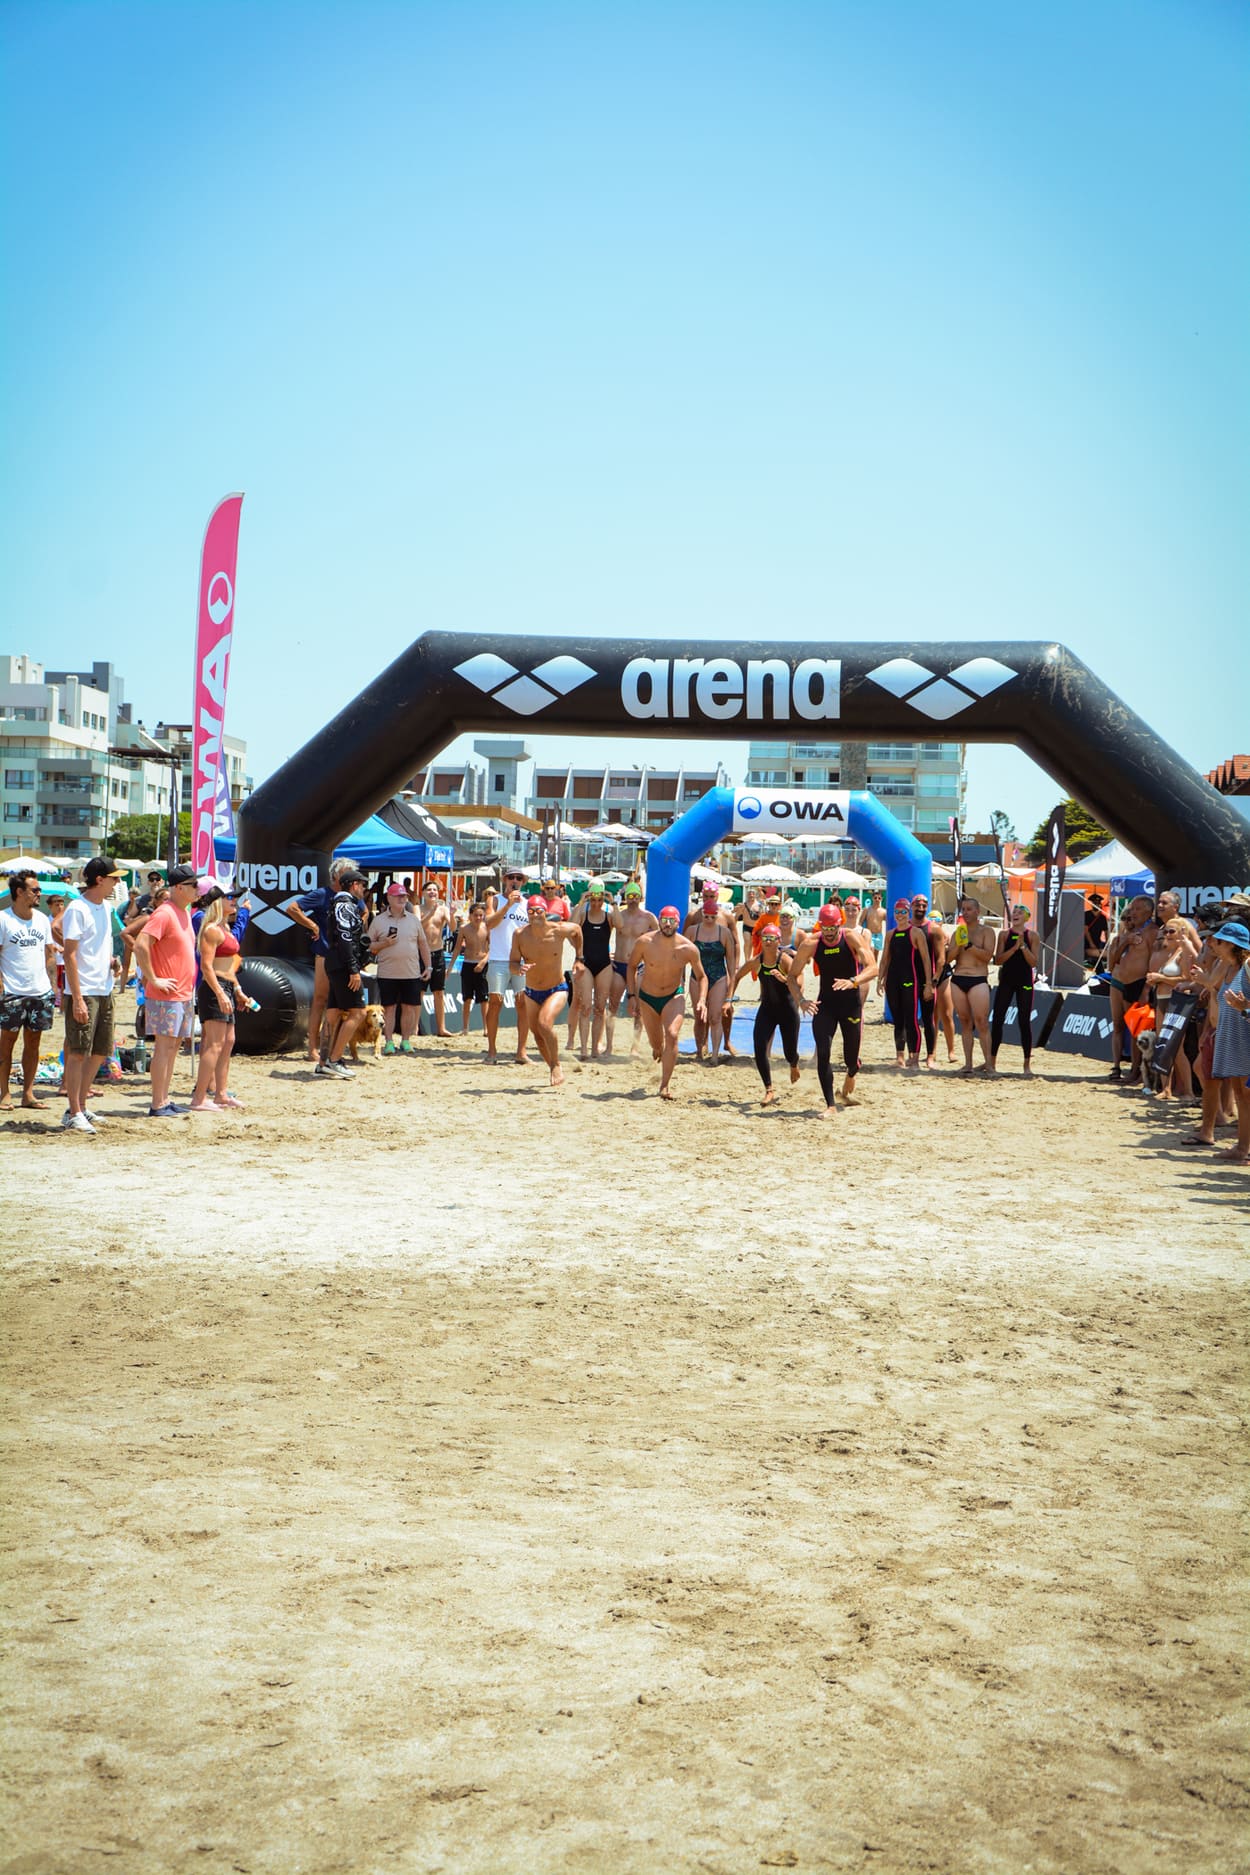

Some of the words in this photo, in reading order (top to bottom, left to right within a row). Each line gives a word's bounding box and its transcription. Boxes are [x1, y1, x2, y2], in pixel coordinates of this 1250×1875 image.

[621, 657, 842, 720] arena
[769, 800, 844, 822] OWA
[239, 863, 318, 891] arena
[9, 929, 26, 944] LIVE
[27, 928, 45, 941] YOUR
[19, 938, 37, 947] SONG
[1062, 1013, 1097, 1036] arena
